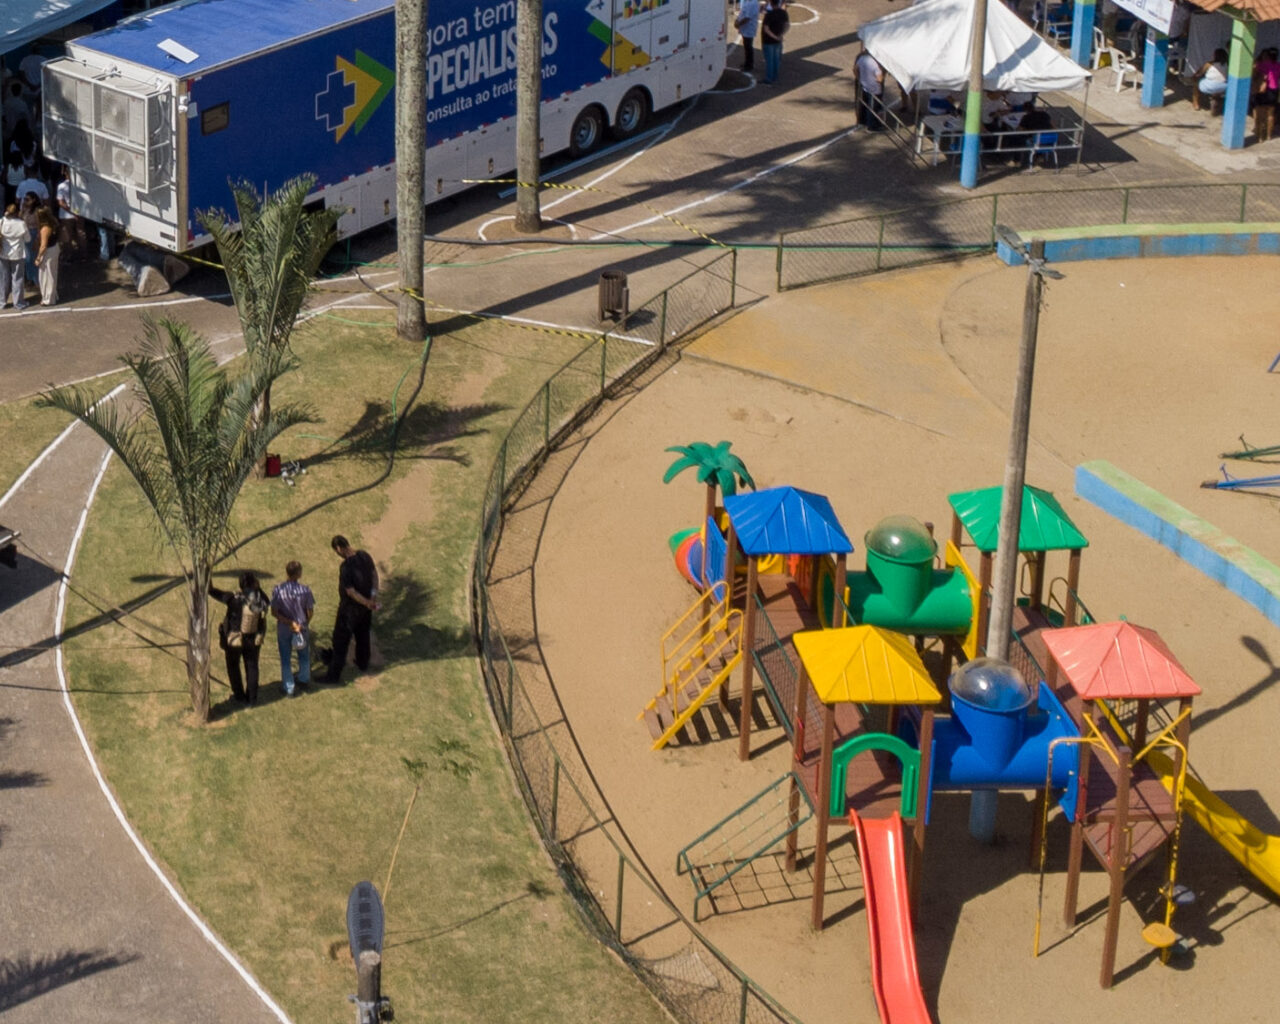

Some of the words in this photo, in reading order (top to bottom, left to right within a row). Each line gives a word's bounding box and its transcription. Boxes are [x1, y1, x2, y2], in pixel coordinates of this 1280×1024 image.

[473, 0, 516, 32] tem
[426, 94, 473, 123] onsulta
[475, 89, 490, 105] ao
